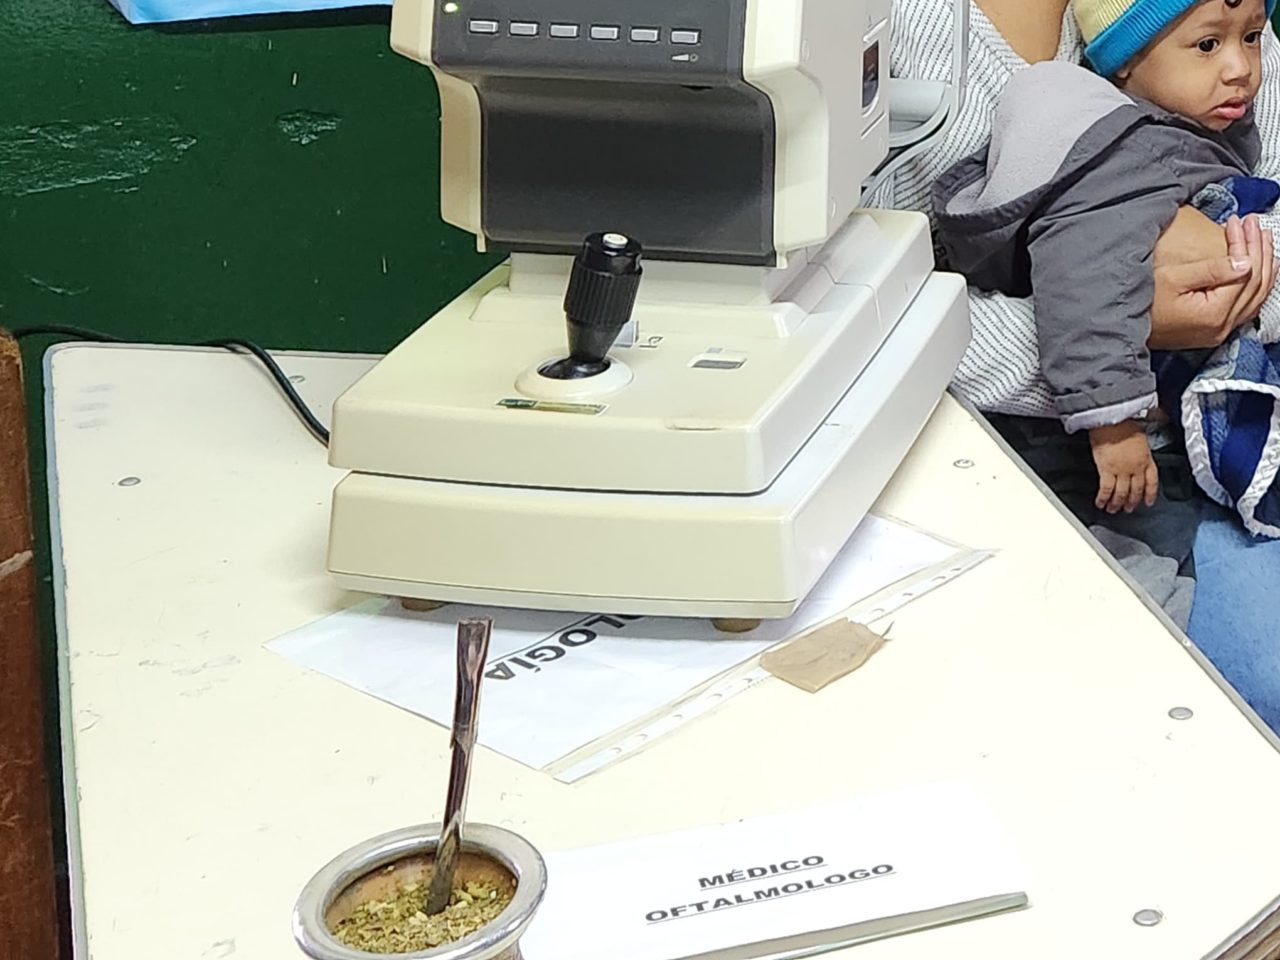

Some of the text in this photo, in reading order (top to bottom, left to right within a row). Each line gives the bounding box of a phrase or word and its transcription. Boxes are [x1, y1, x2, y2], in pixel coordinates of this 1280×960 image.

[484, 614, 645, 682] LOGÍA
[645, 863, 894, 922] OFTALMOLOGO
[698, 855, 825, 889] MÉDICO
